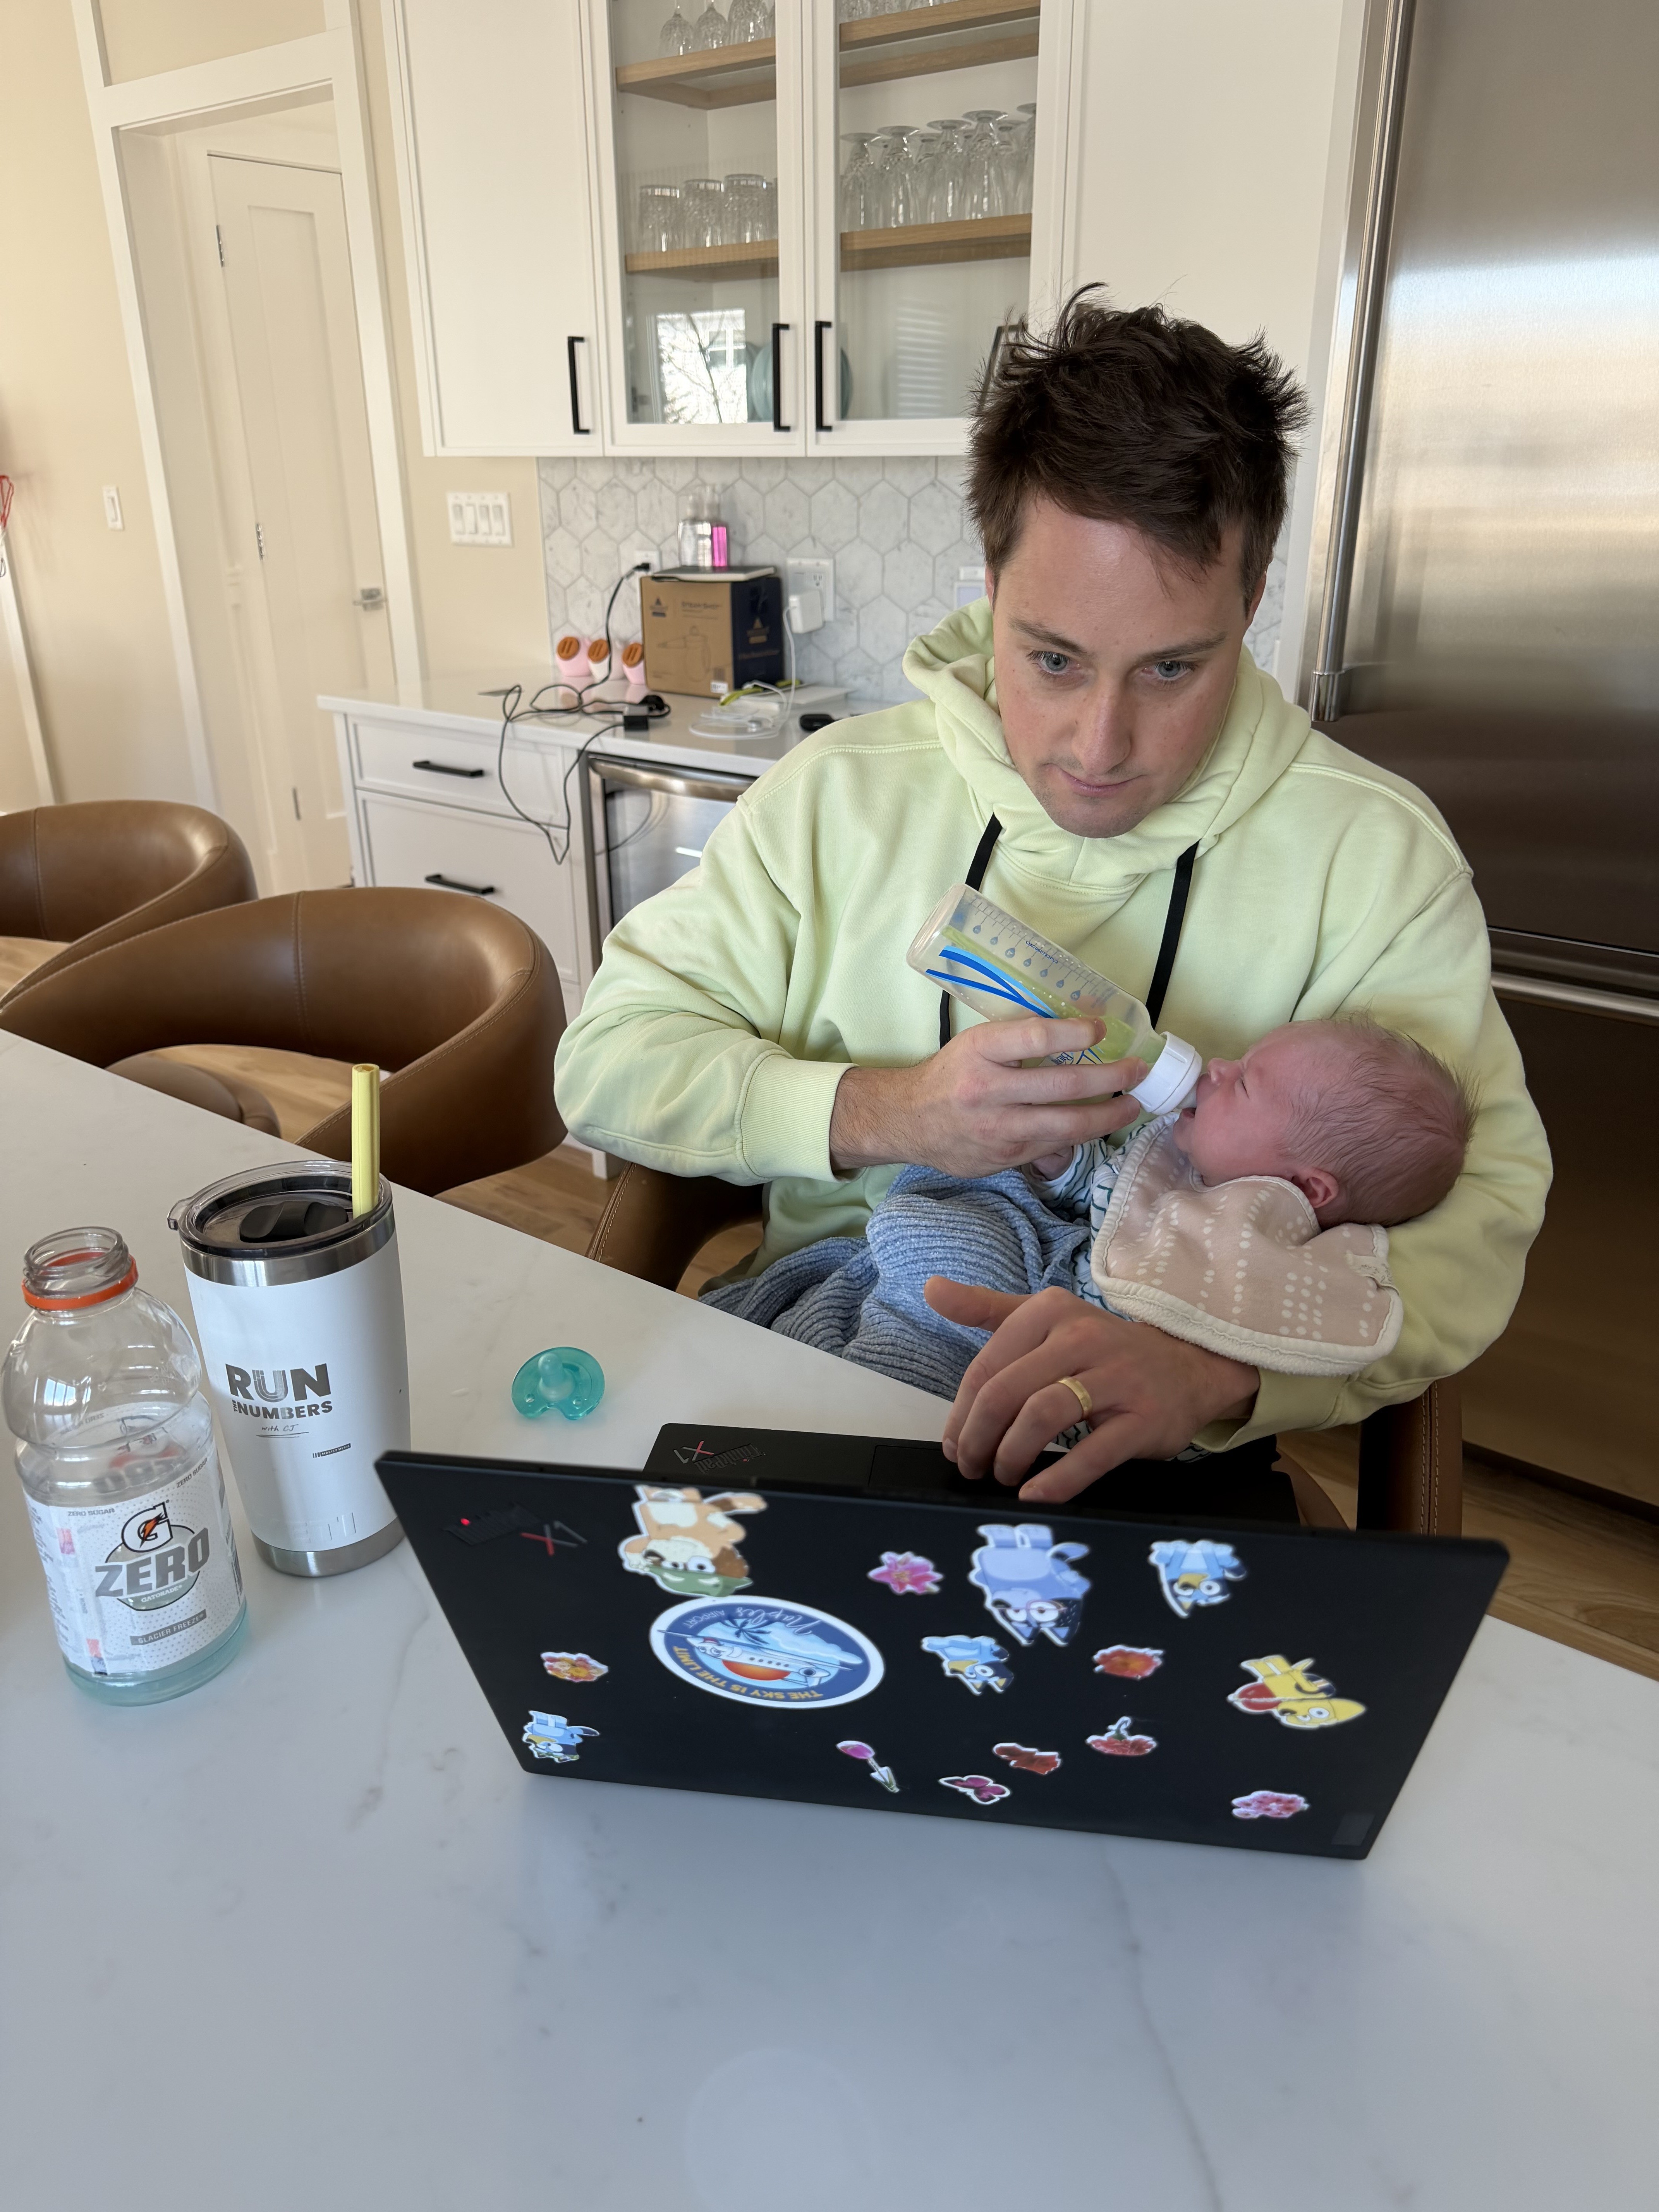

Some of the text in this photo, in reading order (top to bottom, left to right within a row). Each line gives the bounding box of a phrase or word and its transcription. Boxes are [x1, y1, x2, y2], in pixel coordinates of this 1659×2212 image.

[225, 1363, 331, 1402] RUN
[237, 1401, 333, 1419] NUMBERS
[673, 1441, 714, 1464] X1
[176, 1474, 192, 1488] ZERO
[193, 1457, 208, 1476] SUGAR
[520, 1520, 588, 1556] X1
[95, 1527, 210, 1597] ZERO
[683, 1609, 725, 1628] AIRPORT
[737, 1607, 821, 1635] Naples
[138, 1628, 171, 1644] GLACIER
[672, 1646, 824, 1699] THE SKY IS THE LIMIT
